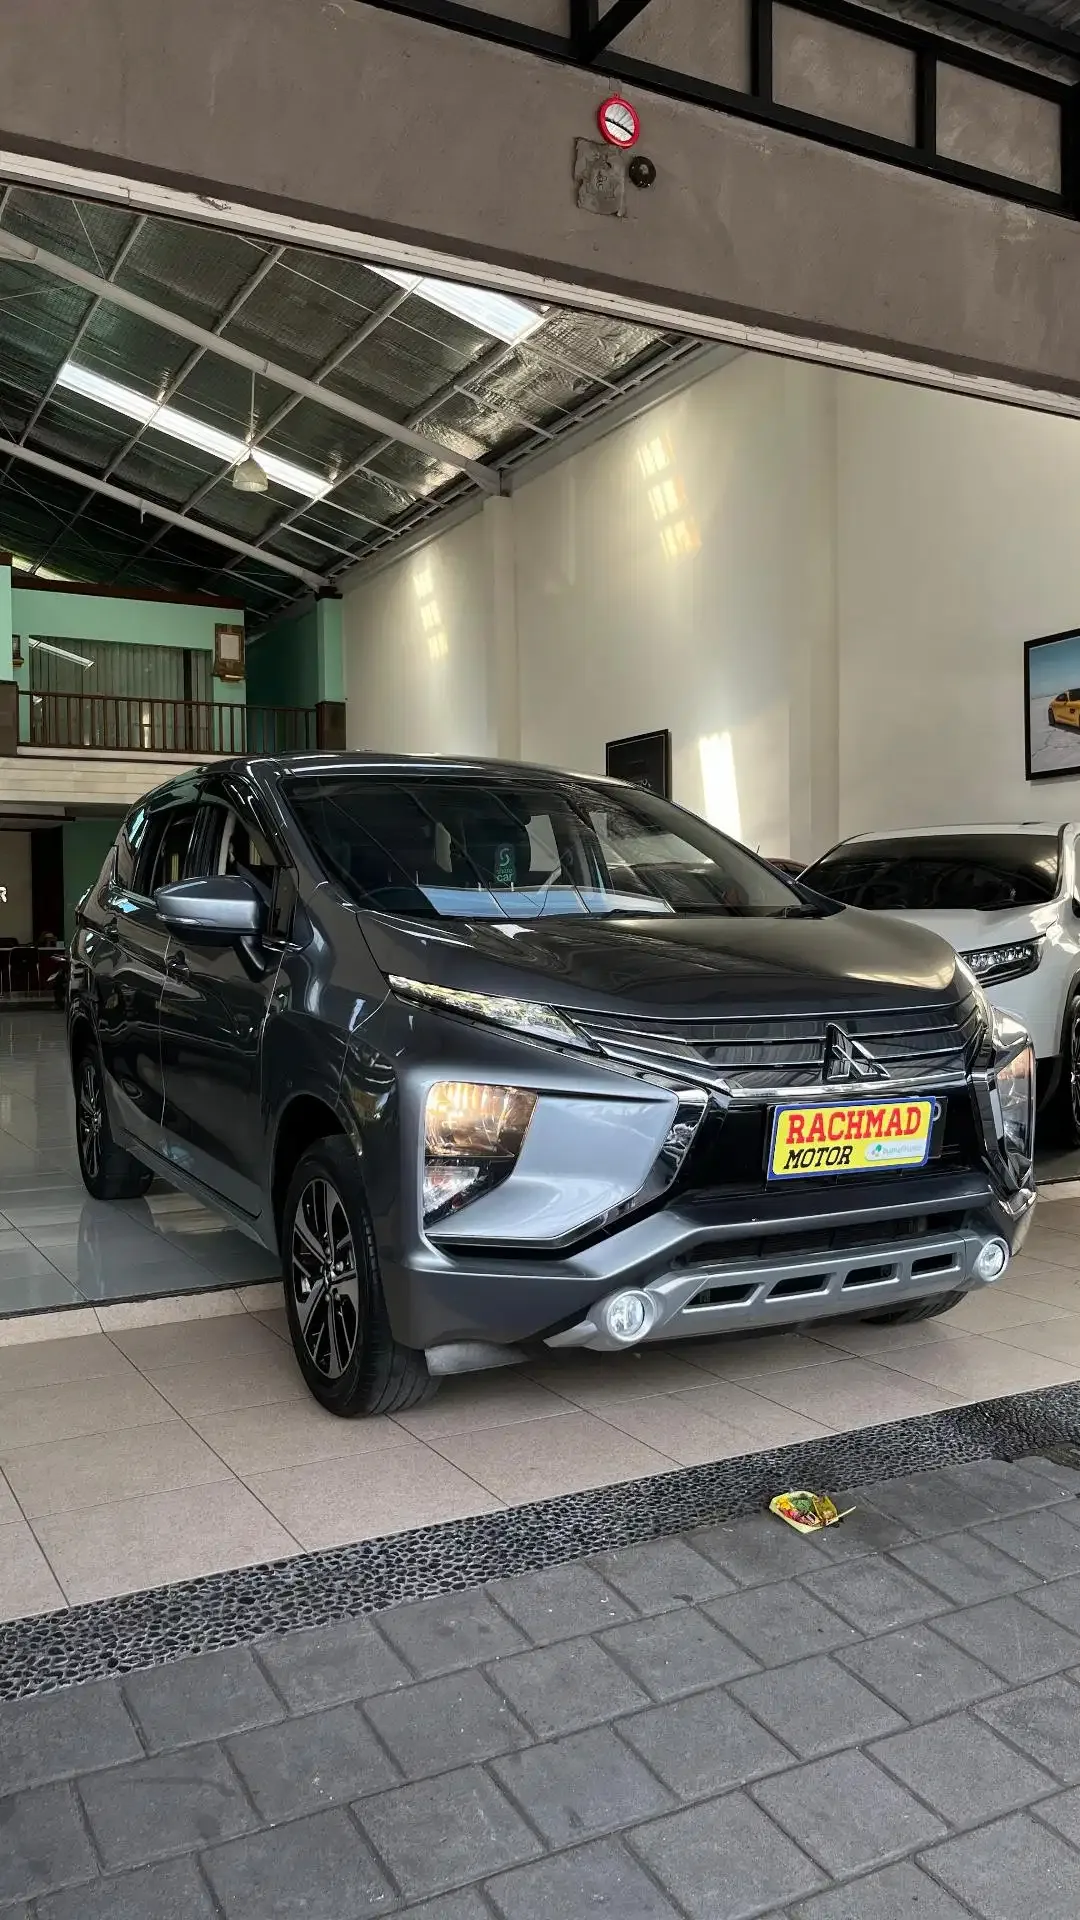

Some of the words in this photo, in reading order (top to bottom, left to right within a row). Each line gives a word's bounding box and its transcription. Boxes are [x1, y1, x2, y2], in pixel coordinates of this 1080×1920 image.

[496, 873, 513, 882] car
[786, 1106, 922, 1145] RACHMAD
[783, 1145, 854, 1170] MOTOR
